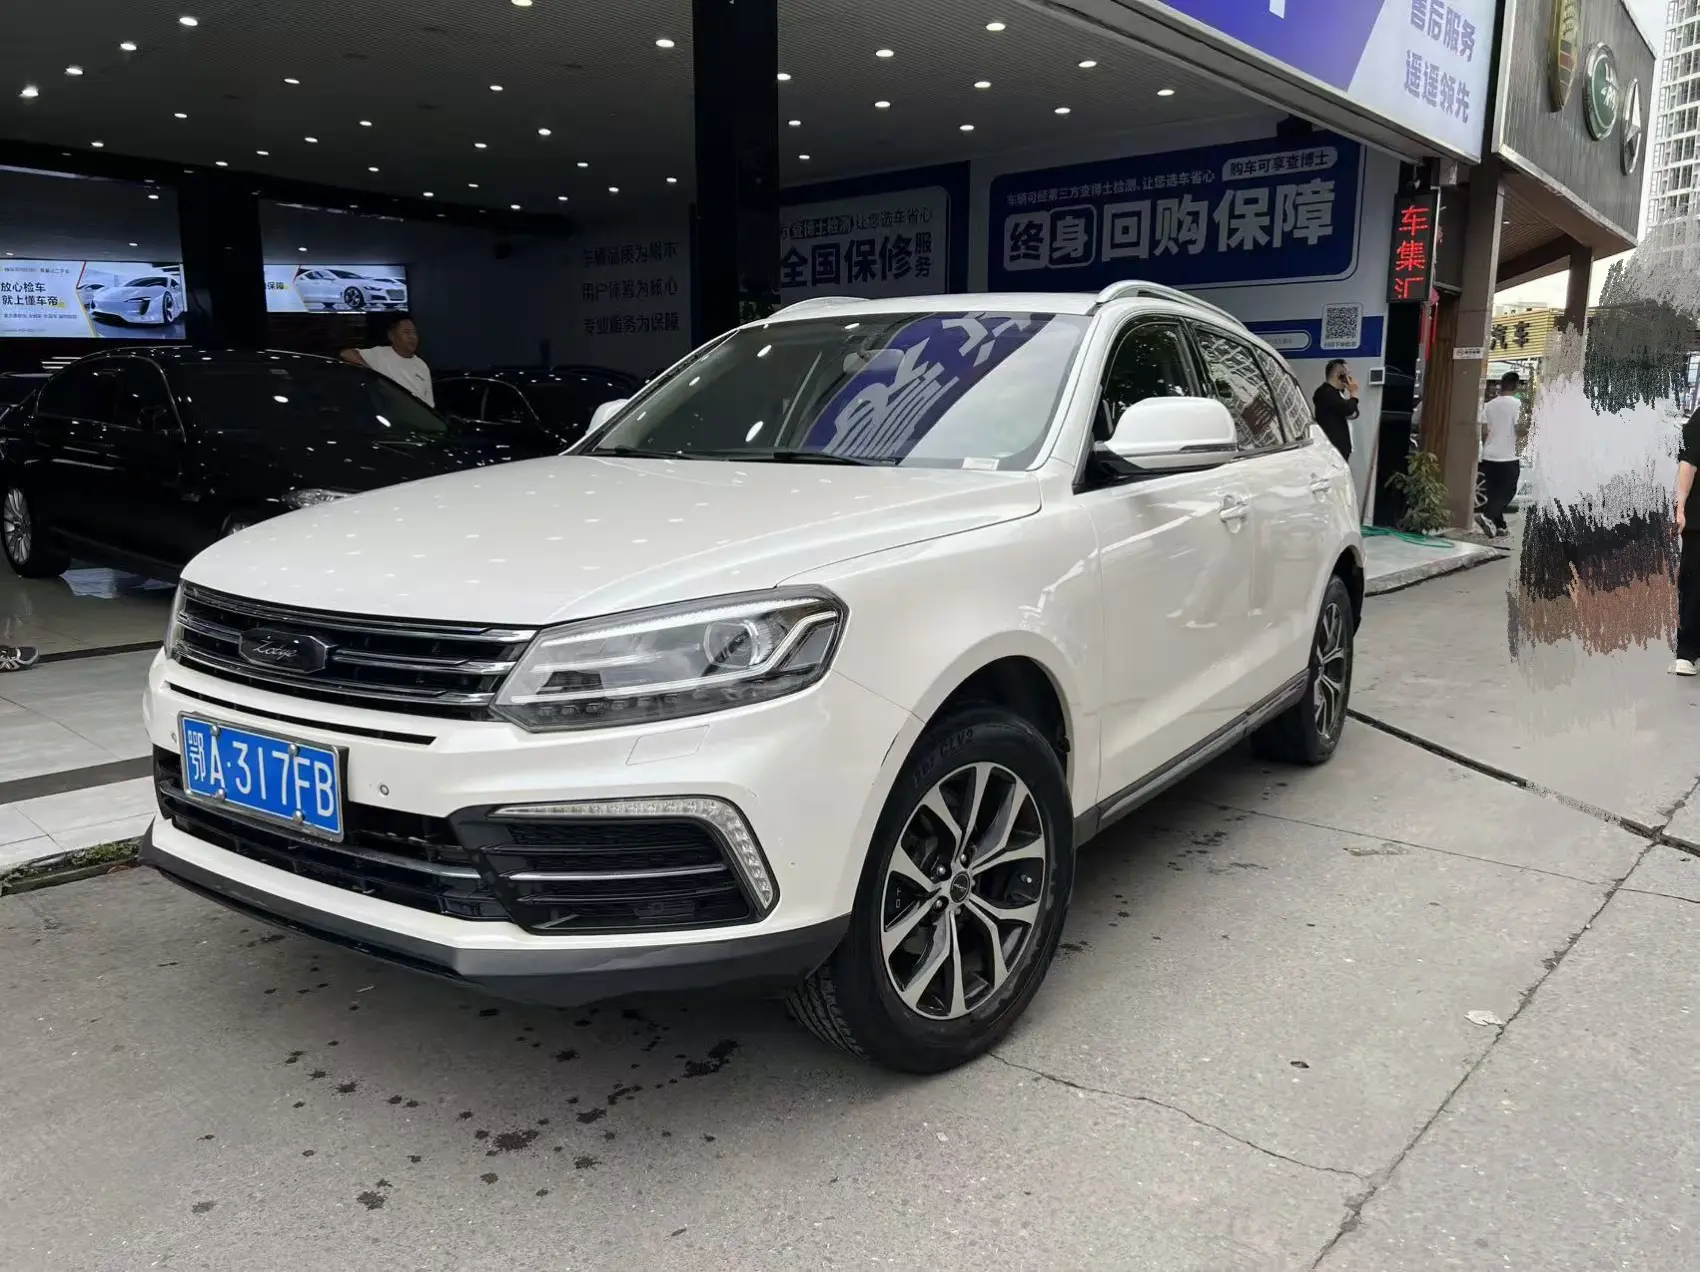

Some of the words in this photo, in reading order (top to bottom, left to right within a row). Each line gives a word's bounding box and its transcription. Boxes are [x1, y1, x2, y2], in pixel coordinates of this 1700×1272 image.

[1410, 0, 1476, 62] 售后服务
[1404, 49, 1471, 124] 遥遥领先
[1230, 150, 1329, 176] 购车可享查博士
[1009, 177, 1337, 262] 终身回购保障
[781, 233, 913, 289] 全国保修
[915, 231, 932, 278] 服务
[1395, 205, 1429, 299] 车集汇
[1, 281, 46, 293] 放心检车
[2, 294, 58, 306] 就上懂车帝
[265, 281, 285, 290] 保障
